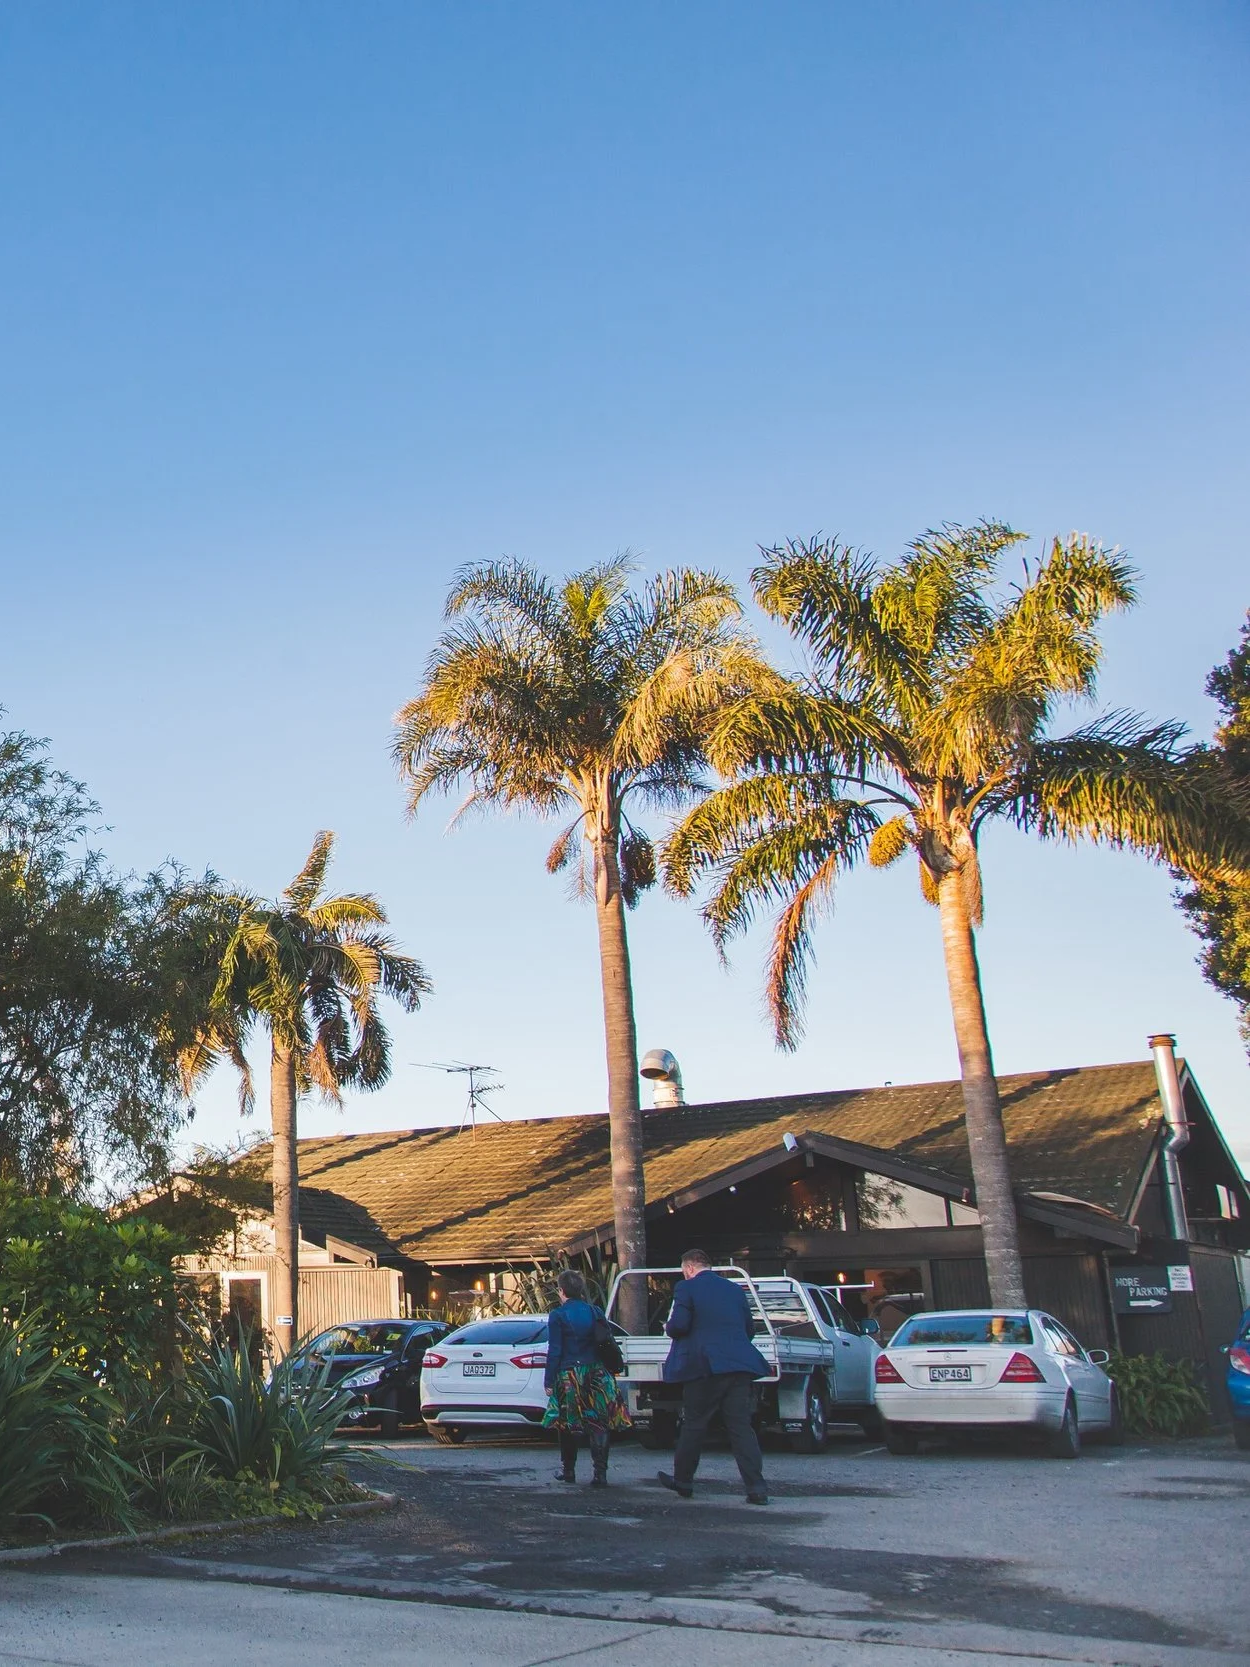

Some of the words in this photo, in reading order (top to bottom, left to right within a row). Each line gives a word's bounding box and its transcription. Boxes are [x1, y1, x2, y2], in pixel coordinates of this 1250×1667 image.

[1115, 1277, 1140, 1287] MORE
[1129, 1287, 1168, 1297] PARKING
[931, 1368, 969, 1379] ENP464
